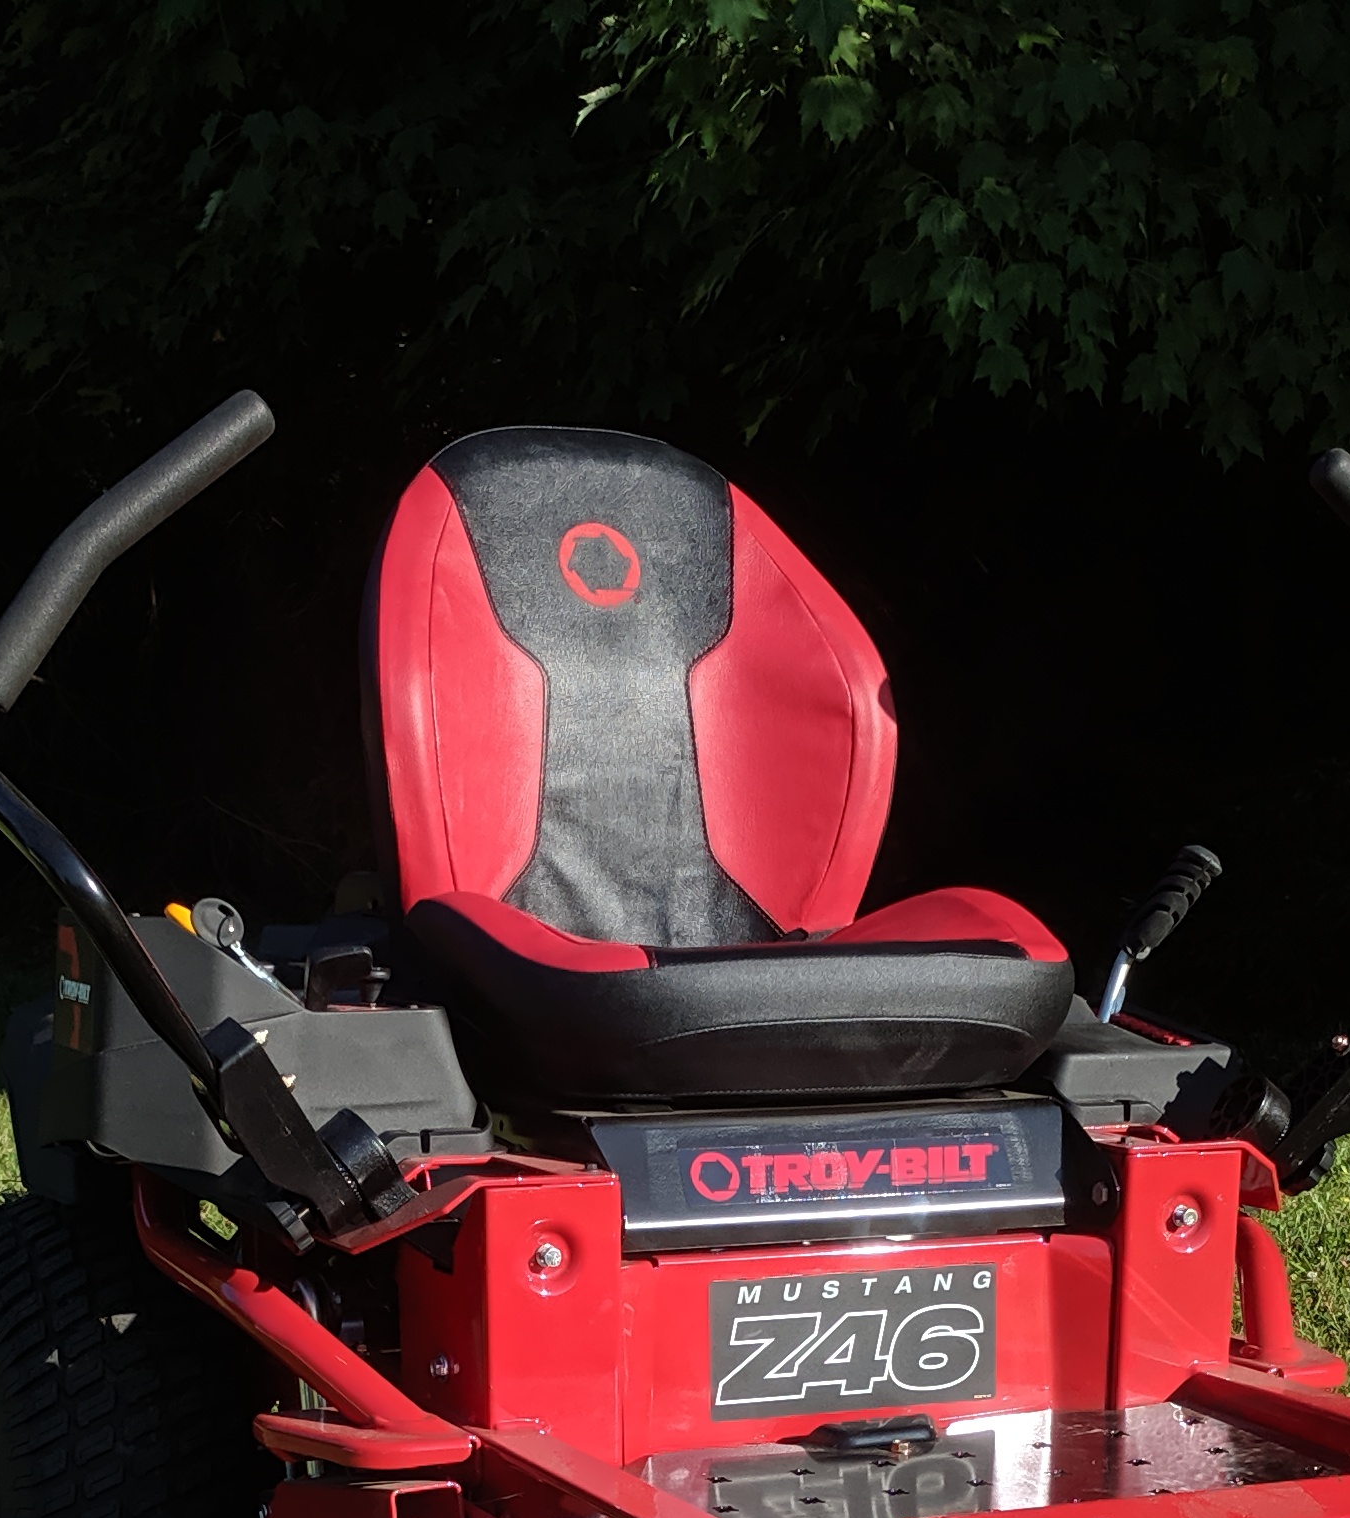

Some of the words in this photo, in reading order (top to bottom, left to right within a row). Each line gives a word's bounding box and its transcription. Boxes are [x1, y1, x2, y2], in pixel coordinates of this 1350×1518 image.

[742, 1143, 993, 1195] TROY-BILT
[737, 1270, 993, 1304] MUSTANG
[716, 1303, 984, 1405] Z46
